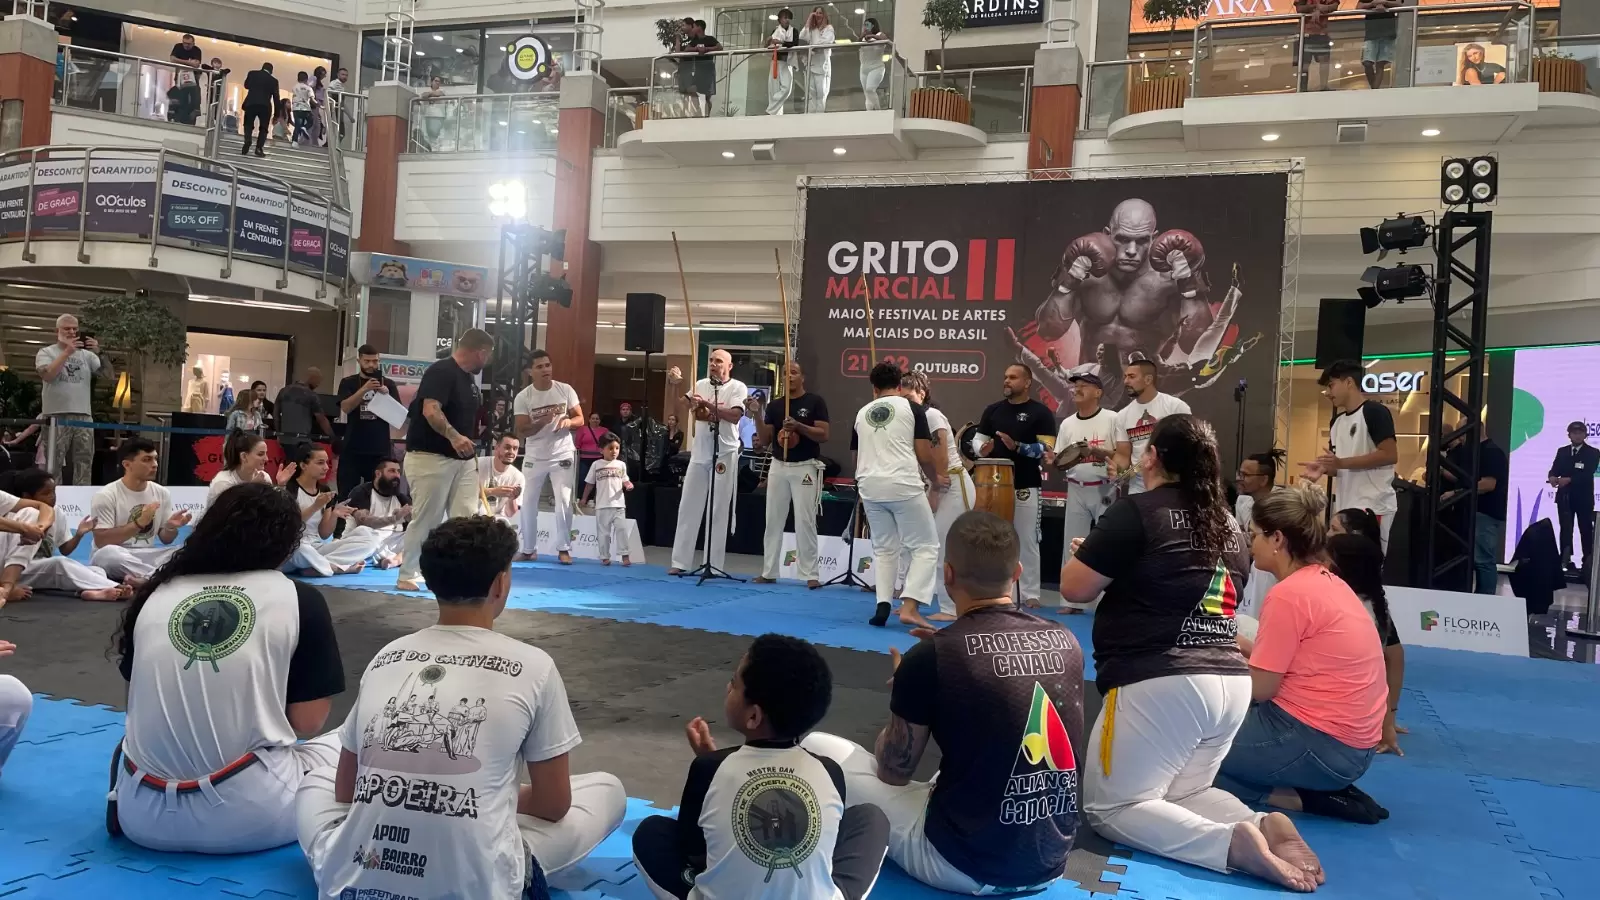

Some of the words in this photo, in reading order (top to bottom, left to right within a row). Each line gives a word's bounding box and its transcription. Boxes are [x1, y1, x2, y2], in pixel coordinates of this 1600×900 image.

[960, 0, 1040, 13] ARDINS
[1200, 0, 1275, 17] ARA
[38, 167, 83, 177] DESCONTO
[172, 180, 228, 196] DESCONTO
[38, 202, 49, 211] DE
[50, 195, 77, 208] GRAÇA
[1, 209, 26, 219] CENTAURO
[174, 214, 196, 225] 50%
[198, 215, 219, 225] OFF
[243, 219, 254, 229] EM
[255, 222, 279, 236] FRENTE
[246, 231, 283, 247] CENTAURO
[293, 239, 302, 247] DE
[827, 240, 959, 275] GRITO
[825, 276, 956, 300] MARCIAL
[828, 308, 875, 320] MAIOR
[878, 309, 938, 321] FESTIVAL
[942, 309, 959, 321] DE
[963, 309, 1007, 321] ARTES
[843, 327, 909, 339] MARCIAIS
[914, 327, 935, 340] DO
[938, 328, 988, 341] BRASIL
[847, 355, 868, 371] 21
[913, 362, 979, 375] OUTUBRO
[1361, 371, 1425, 393] aser
[817, 555, 837, 566] RIPA
[1444, 616, 1500, 632] FLORIPA
[1444, 628, 1501, 638] SHOPPING
[965, 629, 1072, 655] PROFESSOR
[406, 650, 431, 662] DO
[435, 655, 523, 677] CATIVEIRO
[993, 652, 1065, 677] CAVALO
[746, 766, 776, 778] MESTRE
[779, 766, 795, 774] DAN
[790, 781, 810, 797] ARTE
[1004, 771, 1077, 797] ALIANÇA
[354, 773, 481, 820] APOEIRA
[1000, 791, 1078, 825] Capoeira
[372, 823, 411, 845] APOIO
[382, 848, 428, 868] BAIRRO
[380, 860, 425, 878] EDUCADOR
